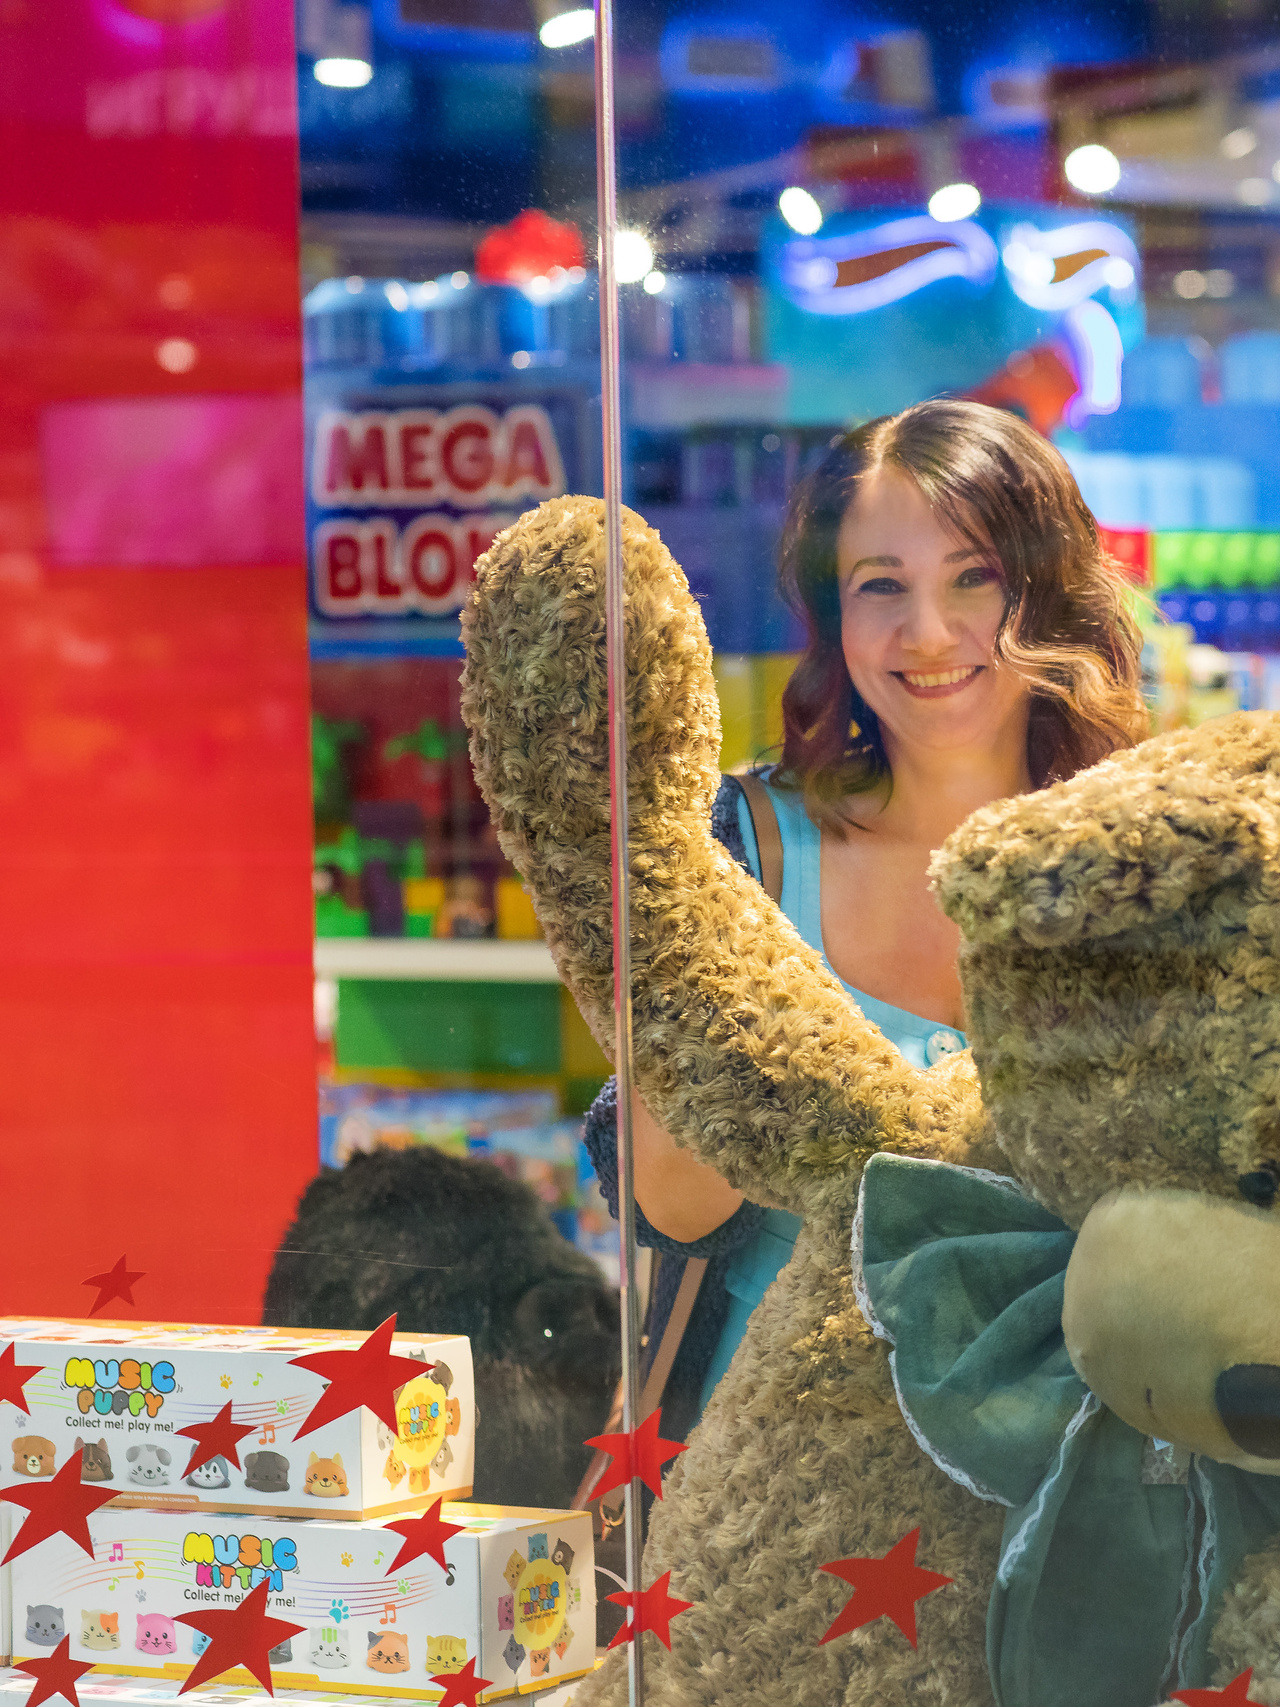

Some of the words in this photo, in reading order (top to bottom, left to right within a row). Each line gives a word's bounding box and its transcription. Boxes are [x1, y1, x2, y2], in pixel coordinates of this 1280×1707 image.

[321, 414, 554, 497] MEGA
[64, 1356, 177, 1394] MUSIC
[77, 1388, 164, 1418] PUPPY
[399, 1402, 440, 1424] MUSIC
[65, 1416, 101, 1428] Collect
[104, 1419, 124, 1430] me!
[127, 1419, 151, 1433] play
[154, 1421, 174, 1432] me!
[183, 1532, 298, 1571] MUSIC
[196, 1563, 284, 1592] KITTEN
[183, 1588, 220, 1602] Collect
[224, 1593, 244, 1603] me!
[275, 1596, 296, 1607] me!
[519, 1581, 559, 1604] MUSIC
